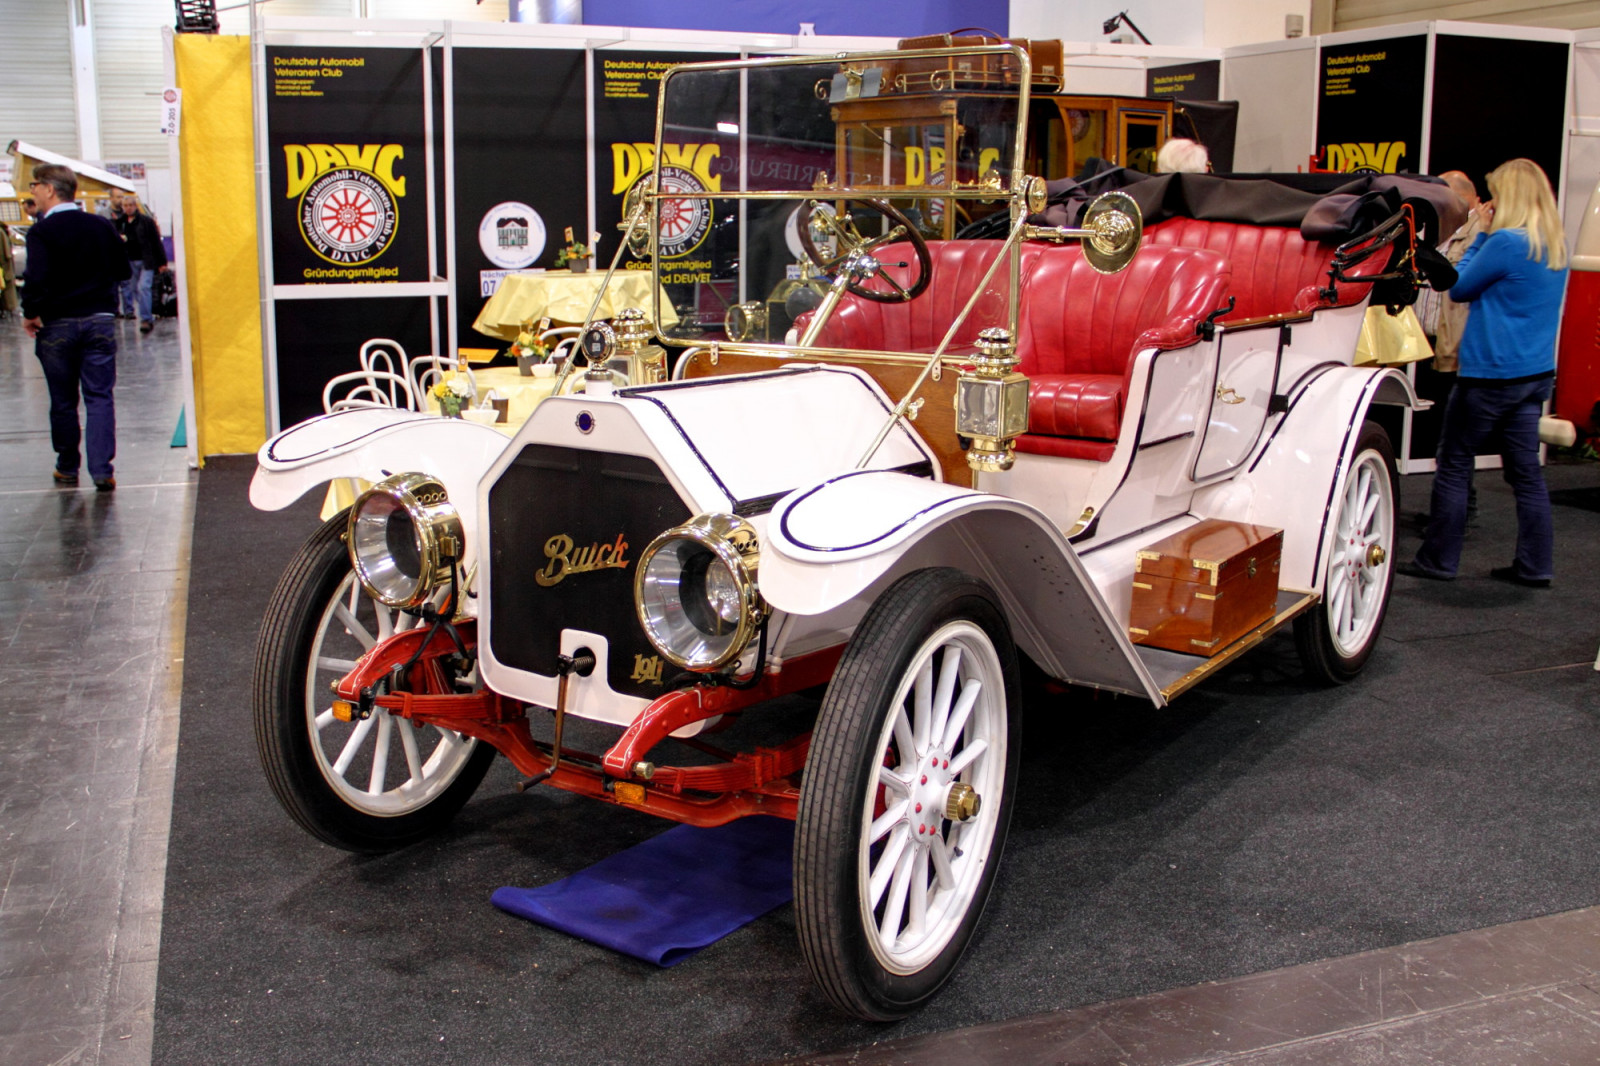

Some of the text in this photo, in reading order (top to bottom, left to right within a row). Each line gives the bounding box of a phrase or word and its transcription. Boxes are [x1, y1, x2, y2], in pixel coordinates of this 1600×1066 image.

[274, 56, 365, 67] Deutscher Automobil
[604, 60, 686, 69] Deutscher Automo
[274, 67, 343, 77] Veteranen Club
[604, 70, 646, 79] Veteranen
[283, 143, 406, 199] DAVC
[302, 205, 328, 254] Deutscher
[331, 248, 372, 263] DAVC
[660, 243, 687, 256] AVC
[303, 266, 399, 279] Gründungsmitglied
[625, 260, 712, 272] Gründngsmitglied
[535, 533, 630, 587] Buick
[630, 654, 664, 685] 1911
